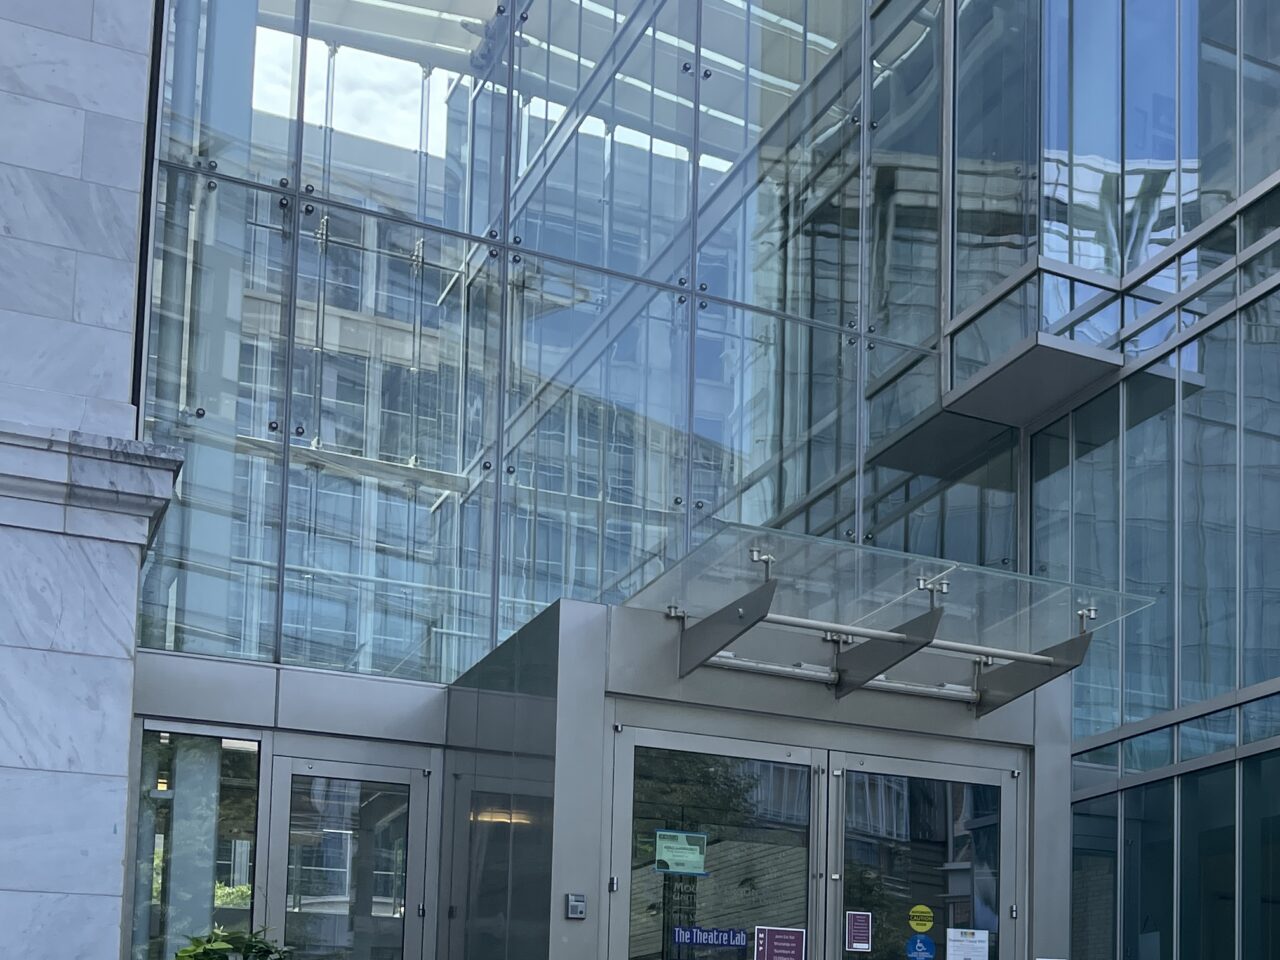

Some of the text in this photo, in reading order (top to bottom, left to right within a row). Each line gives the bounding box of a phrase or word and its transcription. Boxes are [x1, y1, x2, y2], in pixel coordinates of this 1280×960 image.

[674, 927, 746, 946] The Theatre Lab
